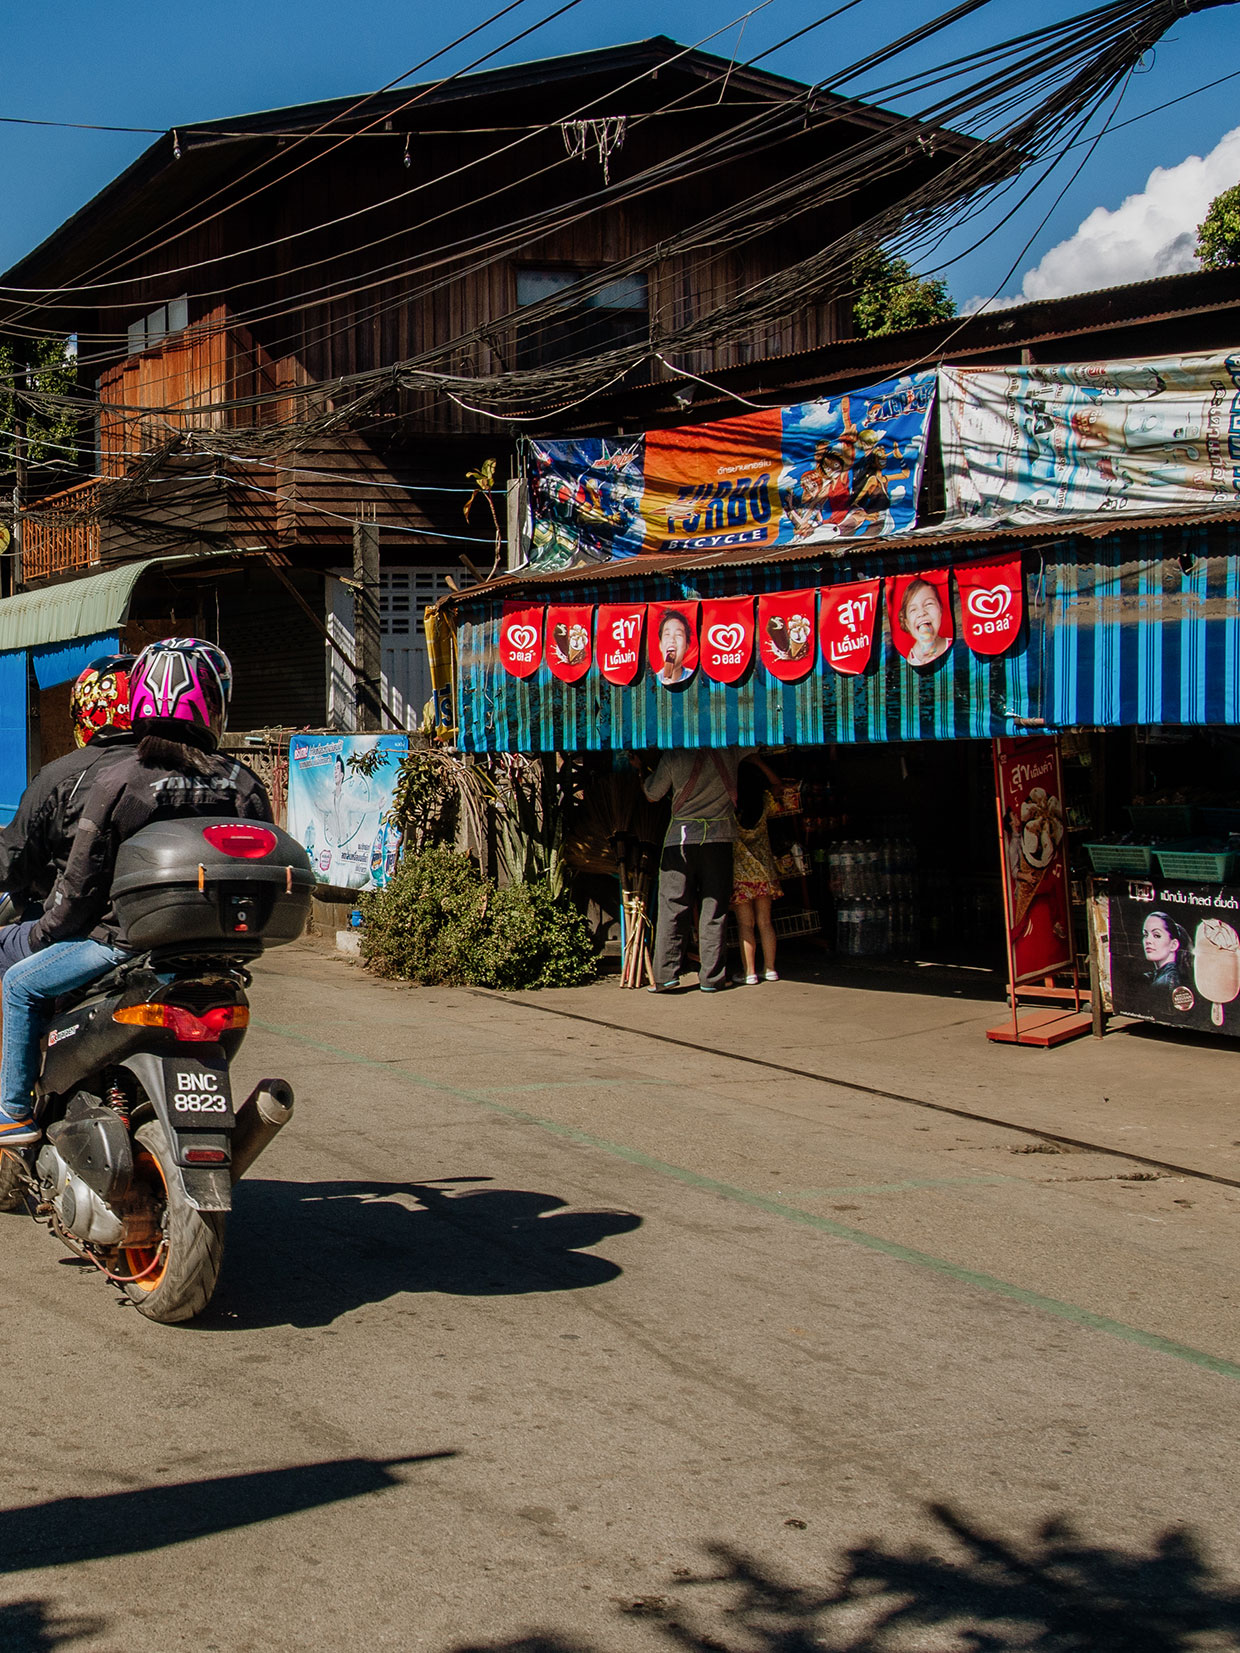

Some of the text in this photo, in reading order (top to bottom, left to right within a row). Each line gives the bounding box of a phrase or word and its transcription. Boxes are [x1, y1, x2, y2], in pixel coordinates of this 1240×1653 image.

[667, 472, 772, 534] TURBO
[668, 530, 762, 549] BICYCLE
[837, 599, 868, 633] สุข
[972, 613, 1010, 636] วอลล์
[612, 618, 636, 649] สุข
[837, 632, 870, 653] เต็มคำ
[509, 649, 536, 663] วอลล์
[711, 650, 742, 665] วอลล์
[1011, 760, 1053, 791] สุข เต็มคำ
[176, 1072, 219, 1092] BNC
[174, 1093, 227, 1113] 8823
